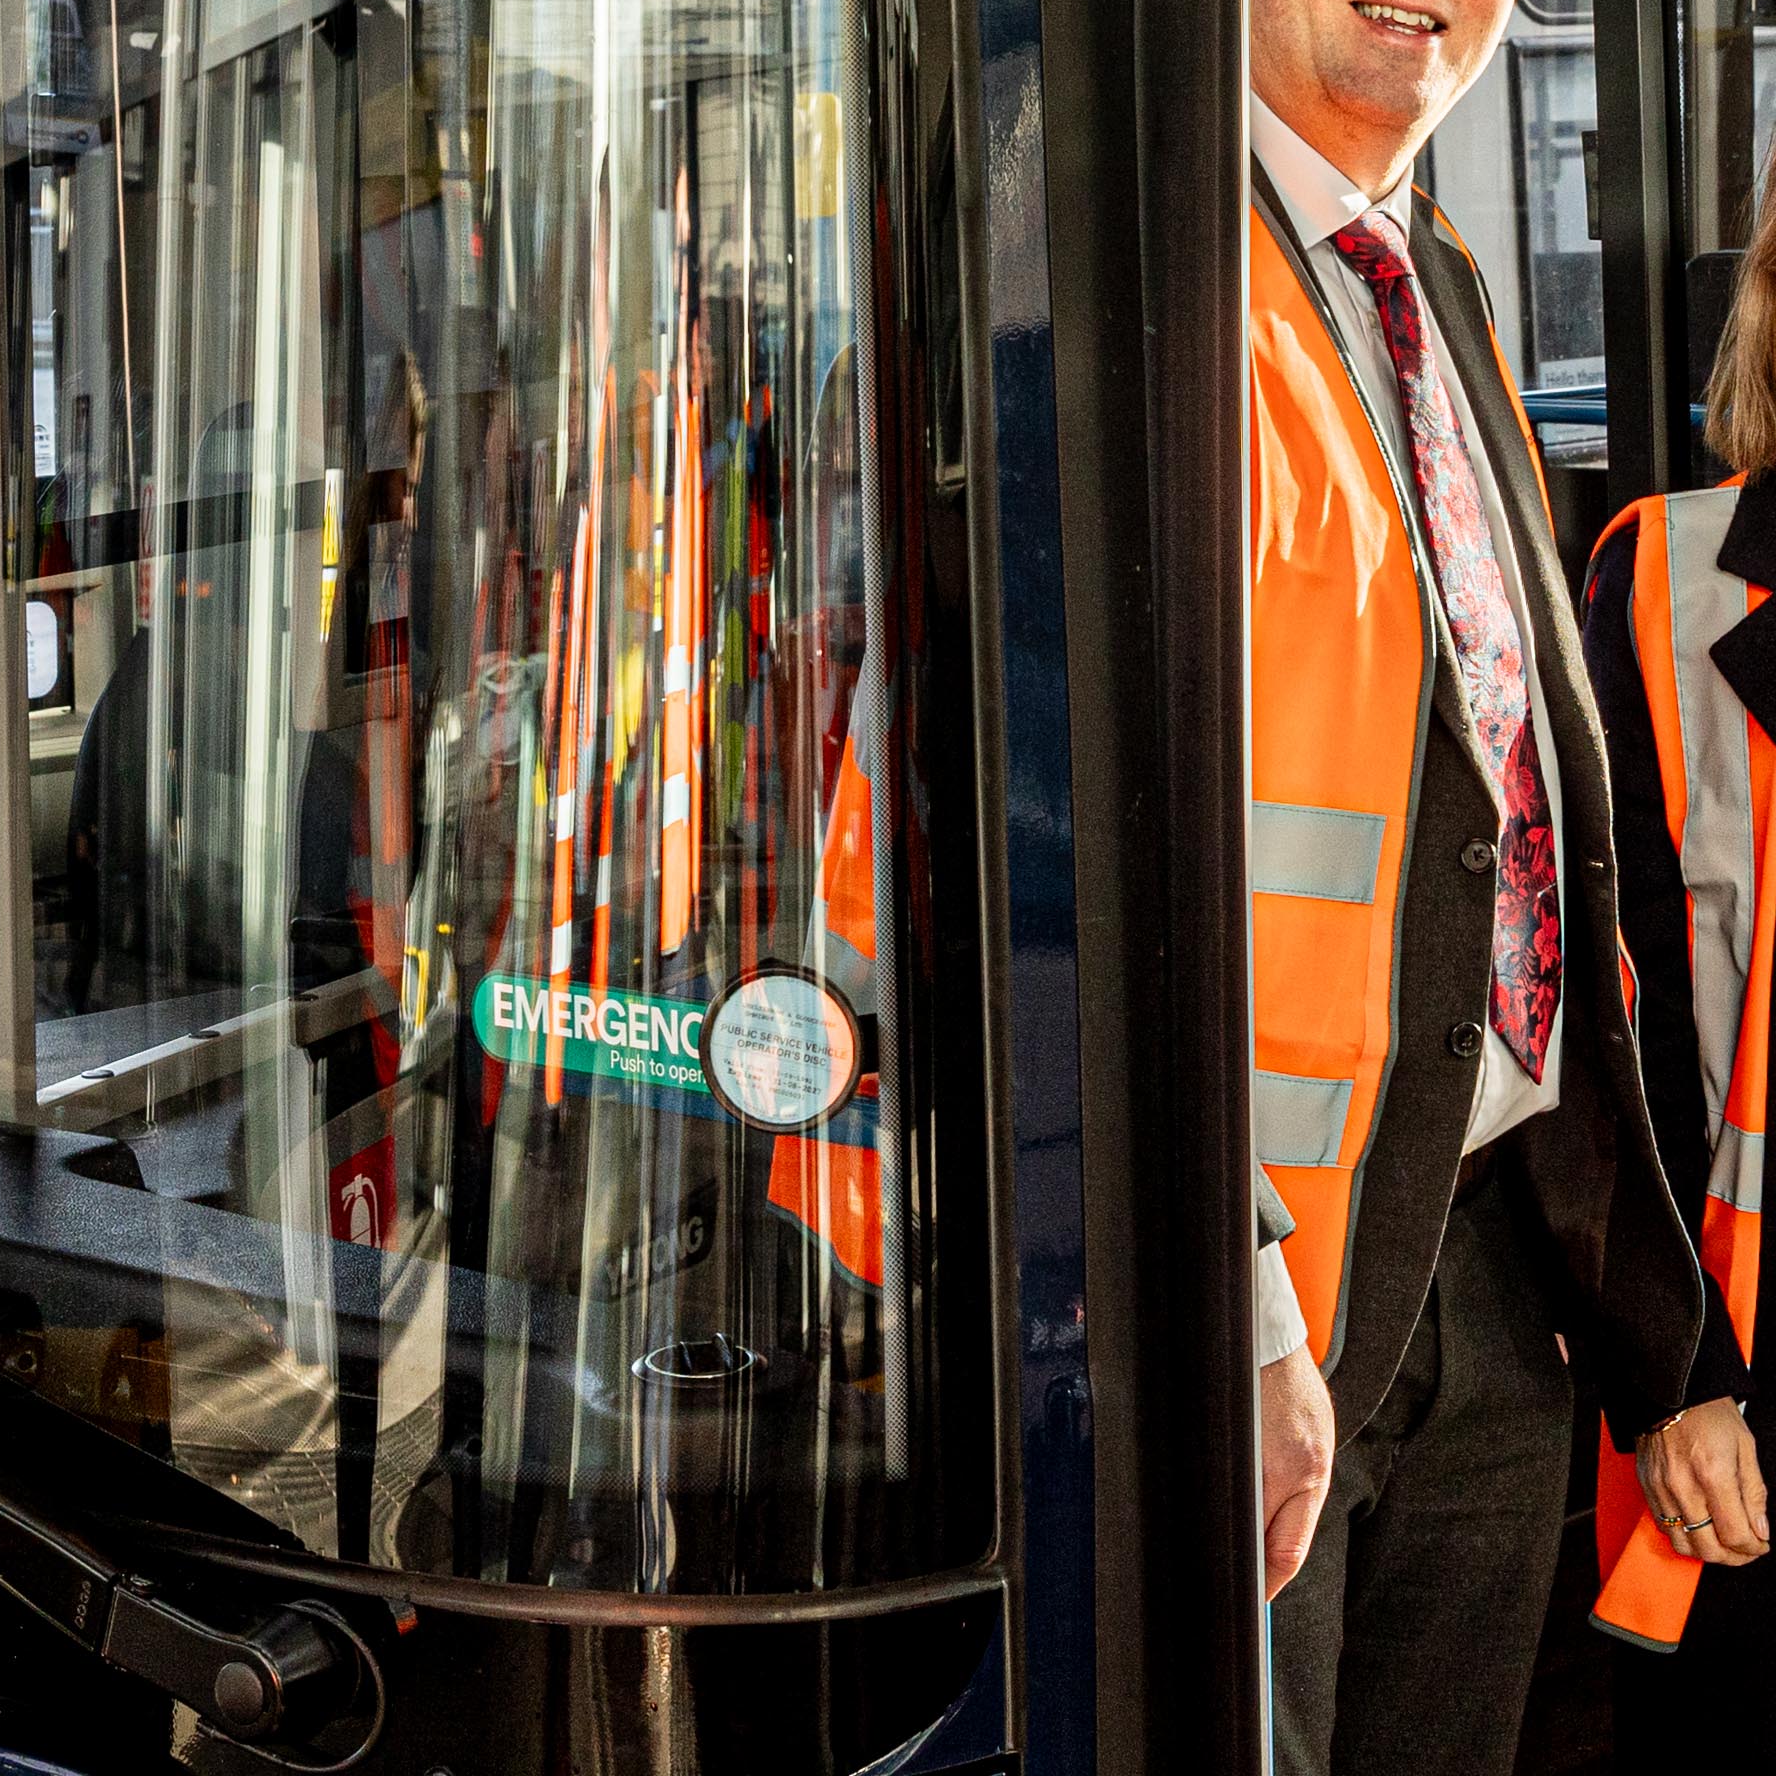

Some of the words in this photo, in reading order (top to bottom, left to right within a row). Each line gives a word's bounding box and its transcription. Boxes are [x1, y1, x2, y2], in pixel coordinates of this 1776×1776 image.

[493, 981, 705, 1060] EMERGENC
[720, 1024, 757, 1039] PUBLIC
[760, 1032, 802, 1049] SERVICE
[805, 1042, 849, 1060] VEHICLE
[737, 1039, 801, 1061] OPERATOR'S
[804, 1054, 827, 1066] DISC
[610, 1050, 647, 1074] Push
[649, 1059, 665, 1076] to
